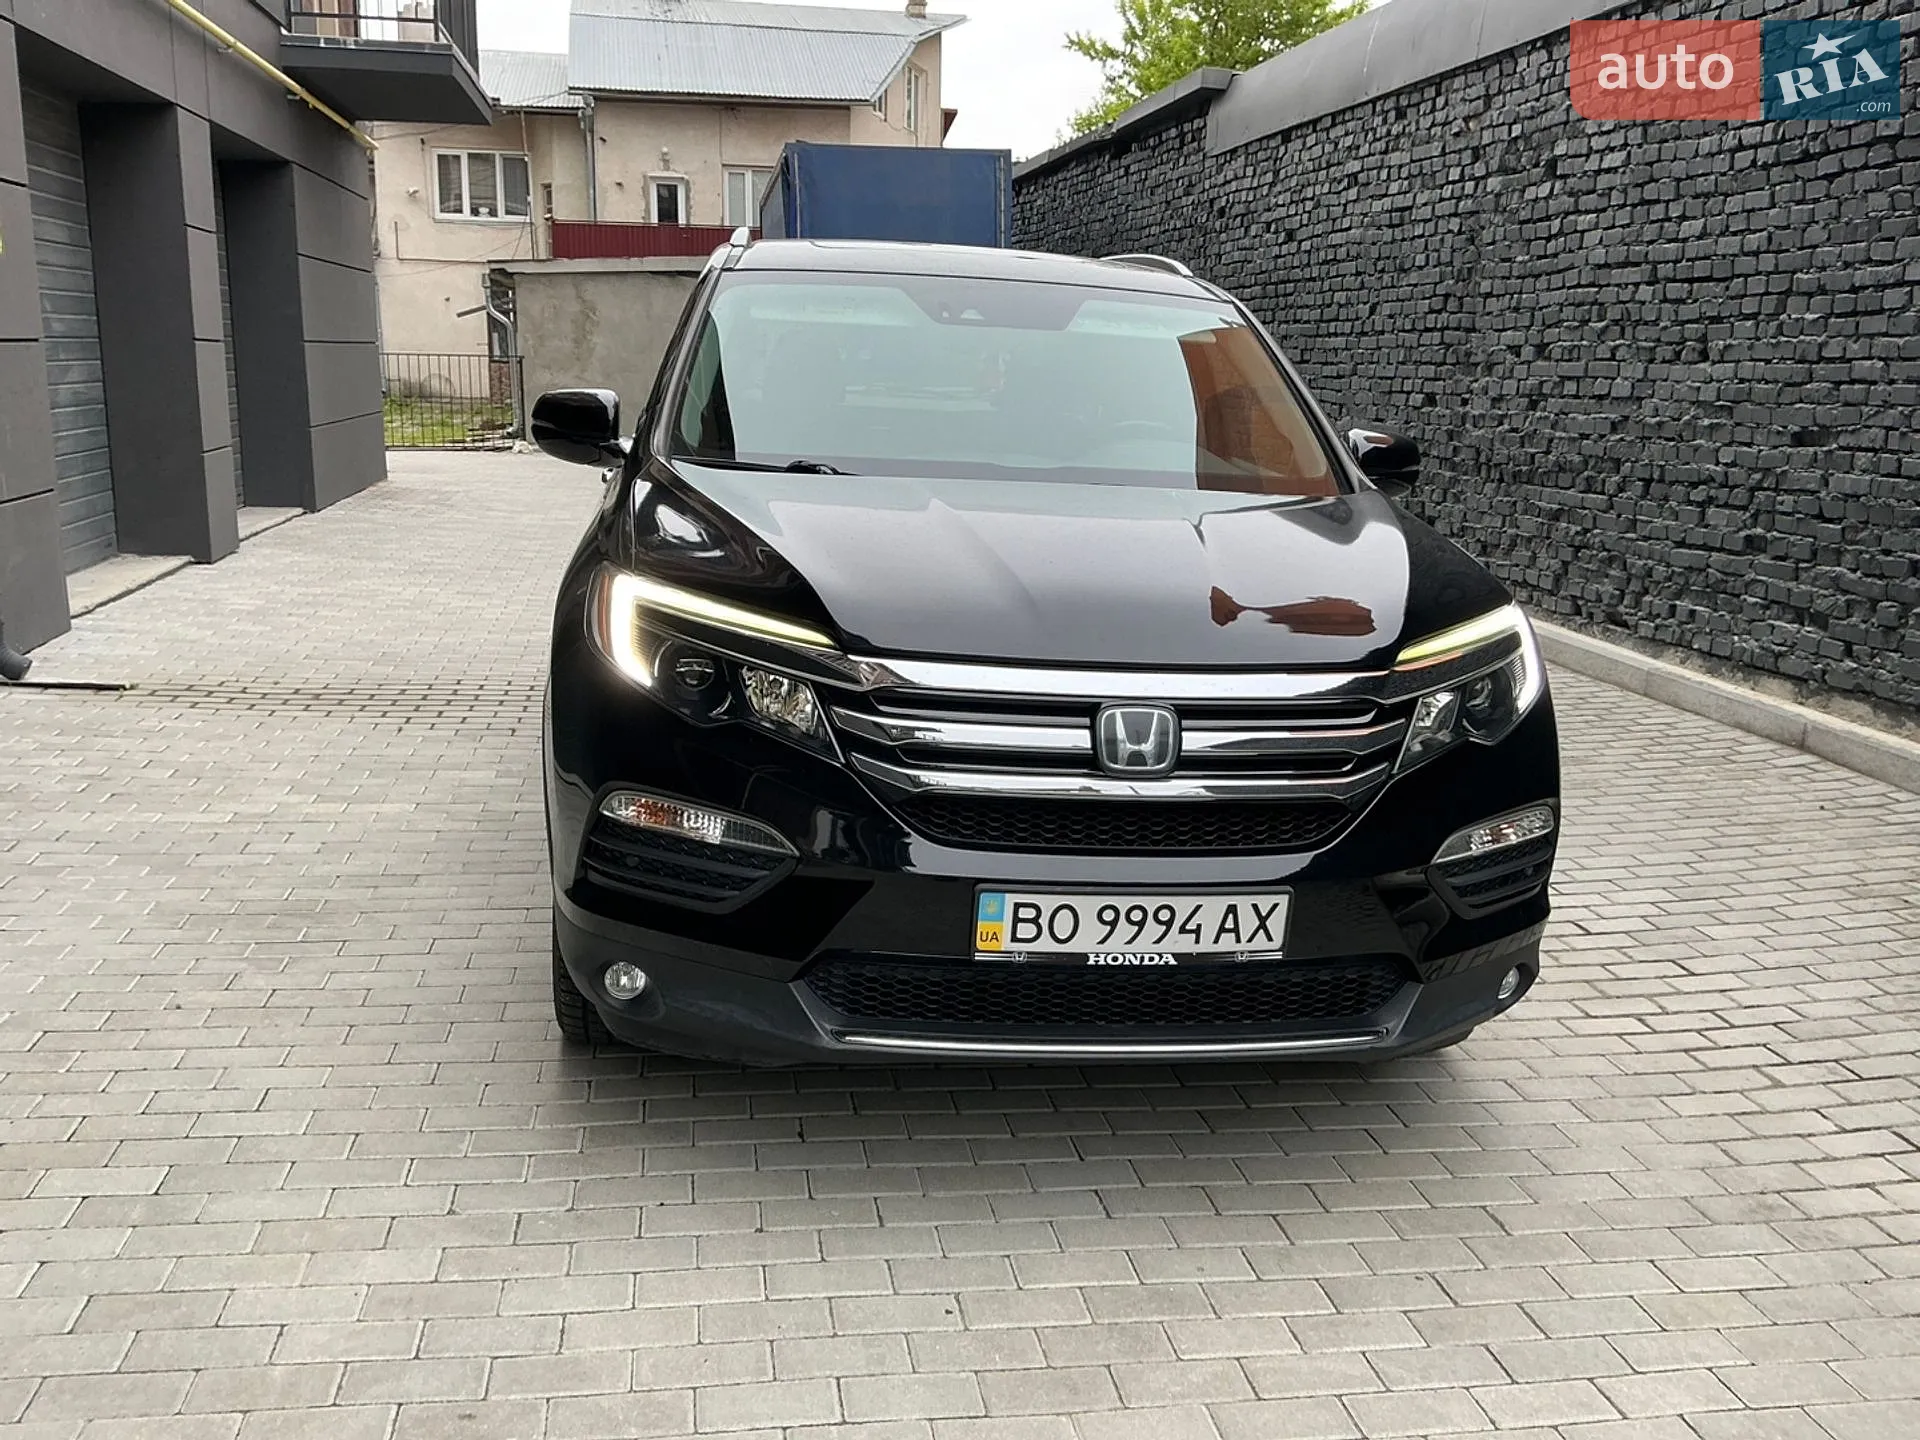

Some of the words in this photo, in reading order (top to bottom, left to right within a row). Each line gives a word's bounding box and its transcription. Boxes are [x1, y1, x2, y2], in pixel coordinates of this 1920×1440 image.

[1010, 901, 1080, 945] BO
[1096, 903, 1203, 945] 9994
[1212, 902, 1280, 944] AX
[979, 931, 1000, 943] UA
[1087, 953, 1178, 966] HONDA
